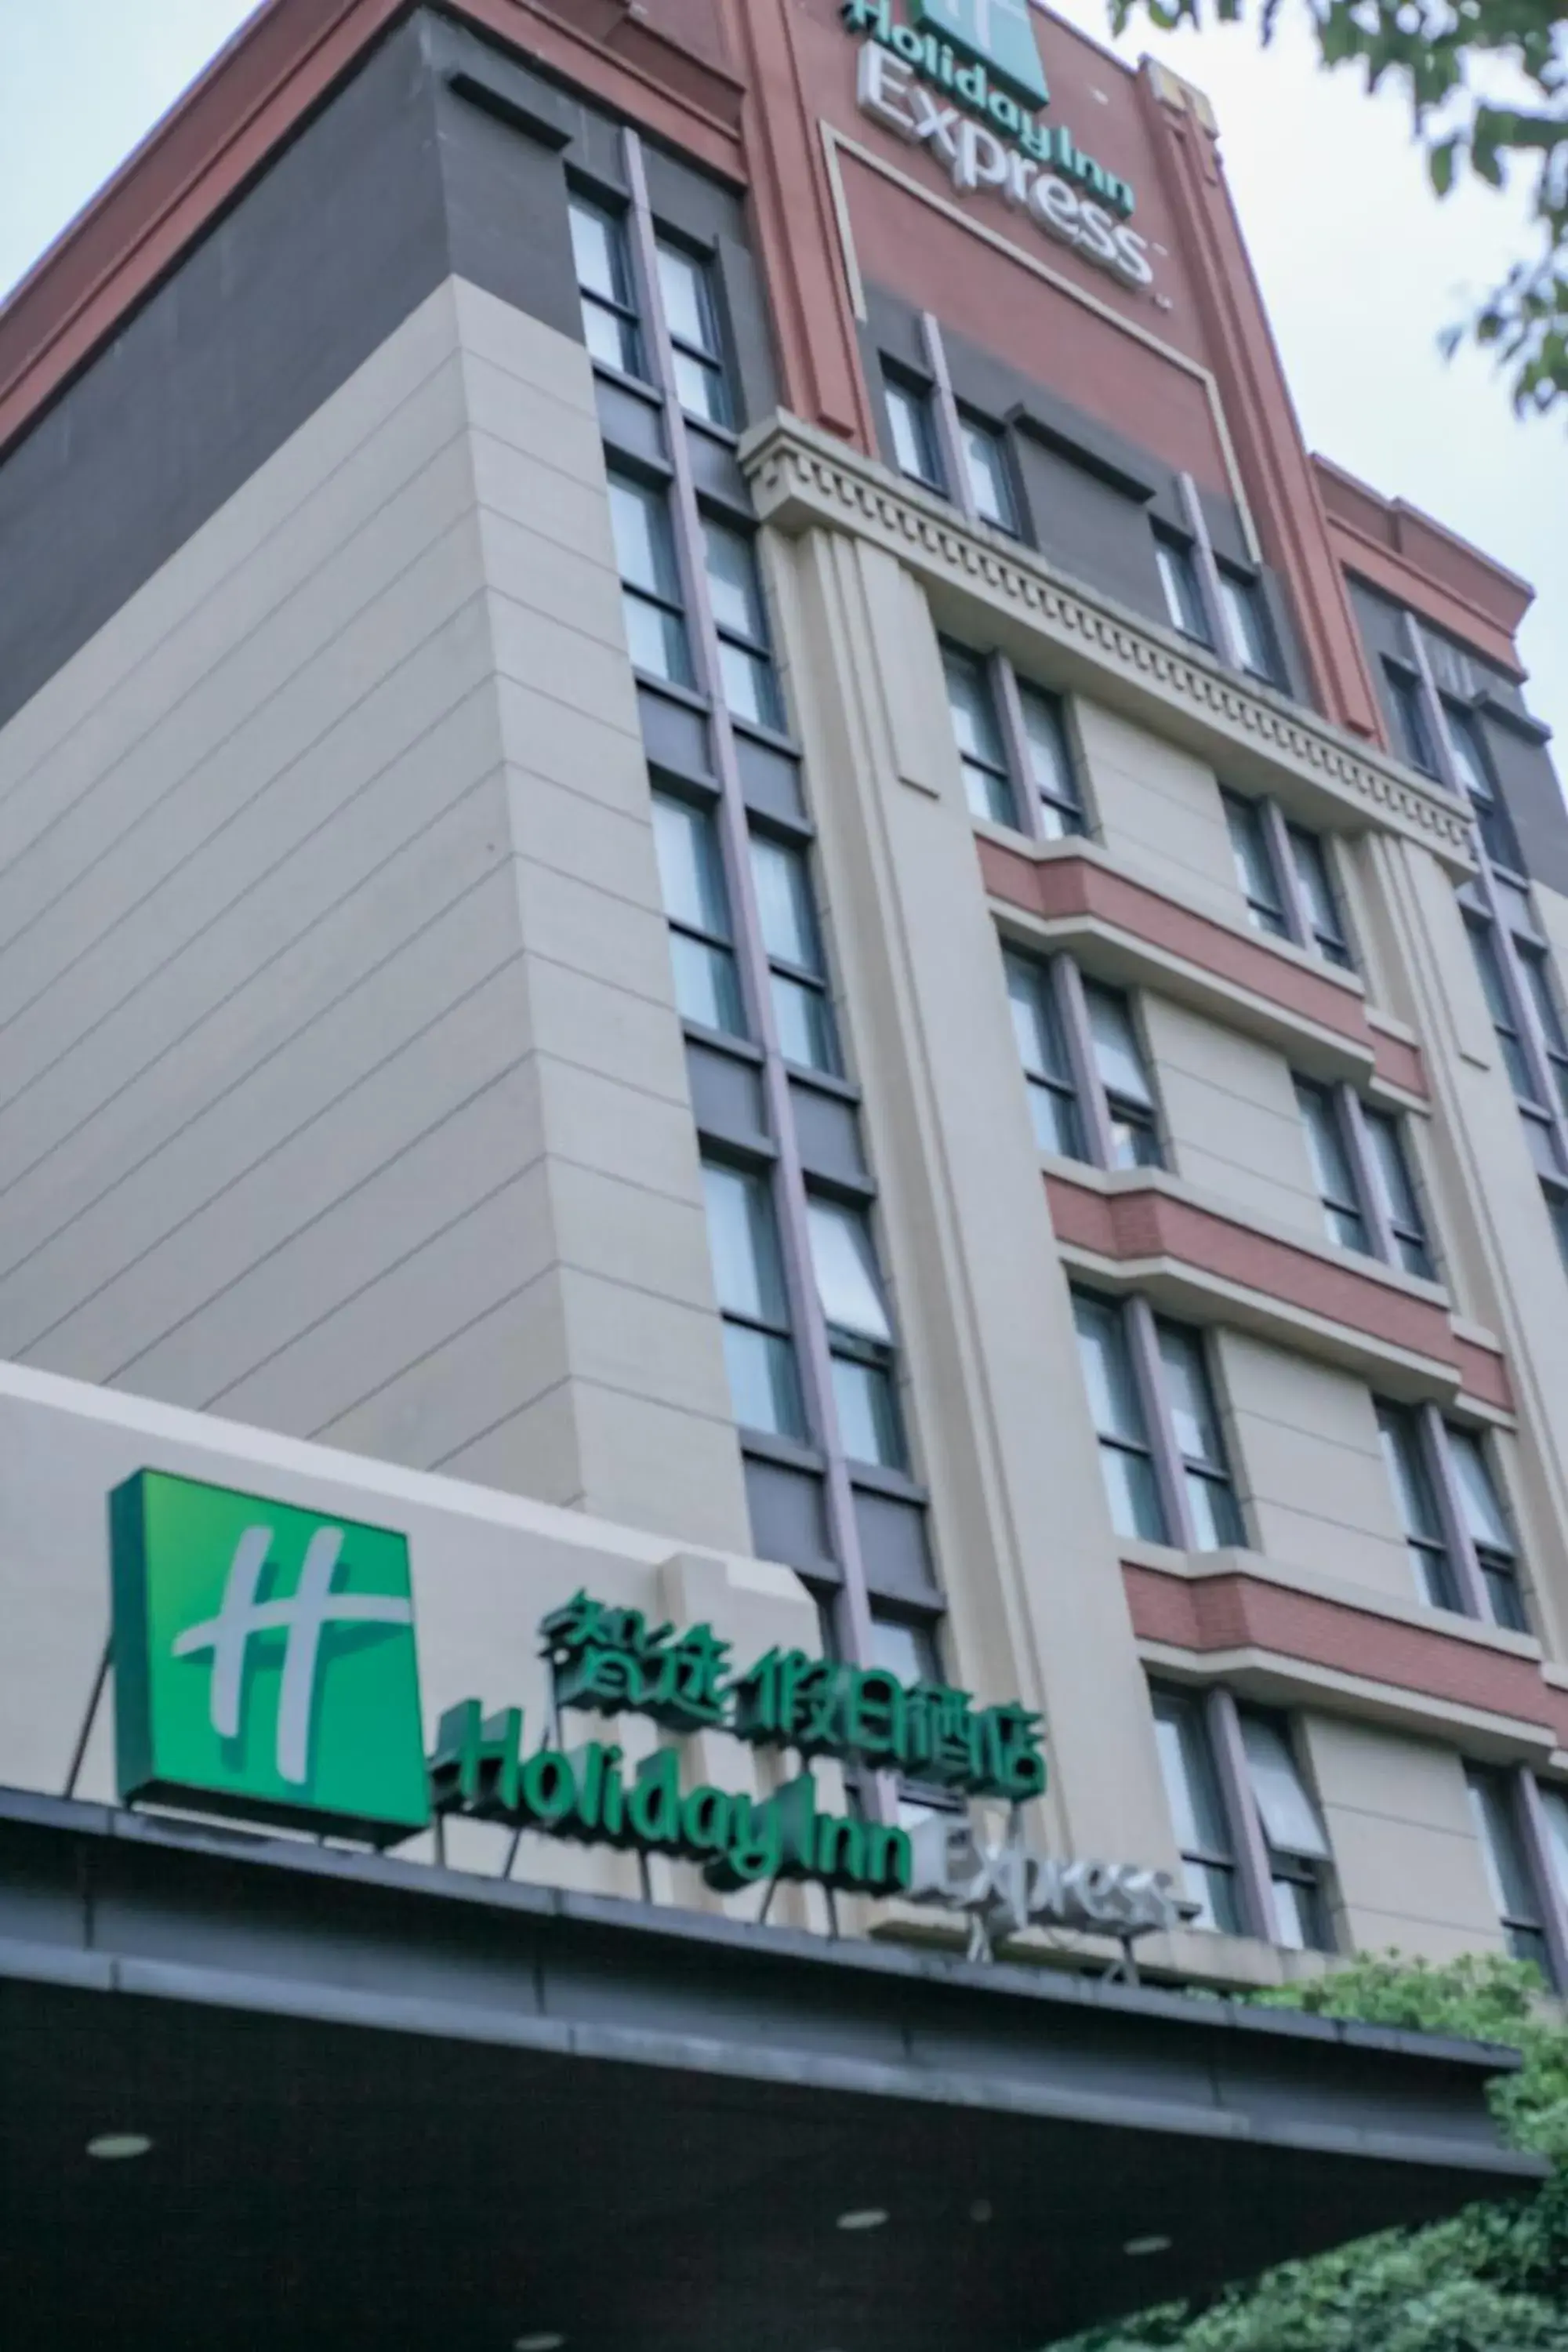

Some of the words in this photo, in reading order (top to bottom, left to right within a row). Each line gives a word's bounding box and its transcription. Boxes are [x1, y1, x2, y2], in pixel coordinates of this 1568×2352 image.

[847, 0, 1052, 162] Holiday
[1055, 124, 1135, 213] Inn
[858, 39, 1153, 287] Express
[539, 1587, 1047, 1800] 智选假日酒店
[443, 1697, 786, 1882] Holiday
[793, 1772, 913, 1889] Inn
[919, 1816, 1175, 1930] Express
